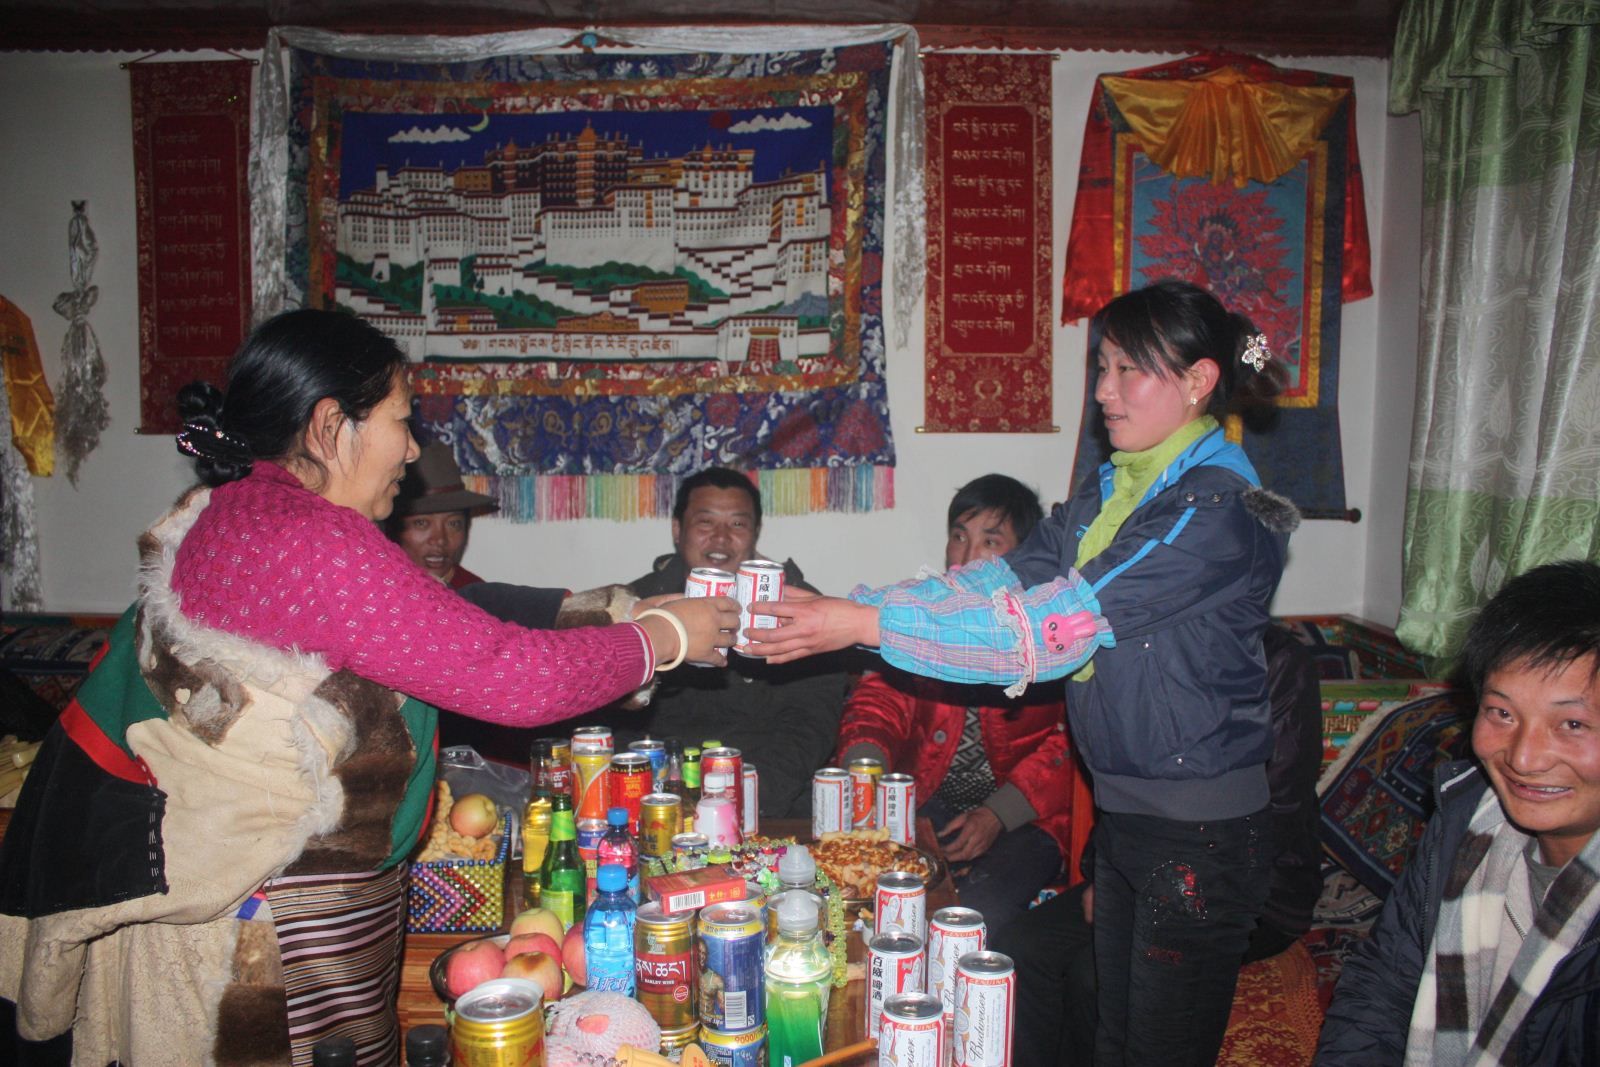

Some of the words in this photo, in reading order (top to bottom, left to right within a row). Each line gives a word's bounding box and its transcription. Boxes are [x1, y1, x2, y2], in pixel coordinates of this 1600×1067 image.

[759, 574, 770, 602] 百威啤
[872, 955, 883, 1001] 百威啤酒
[968, 991, 986, 1062] Budweiser
